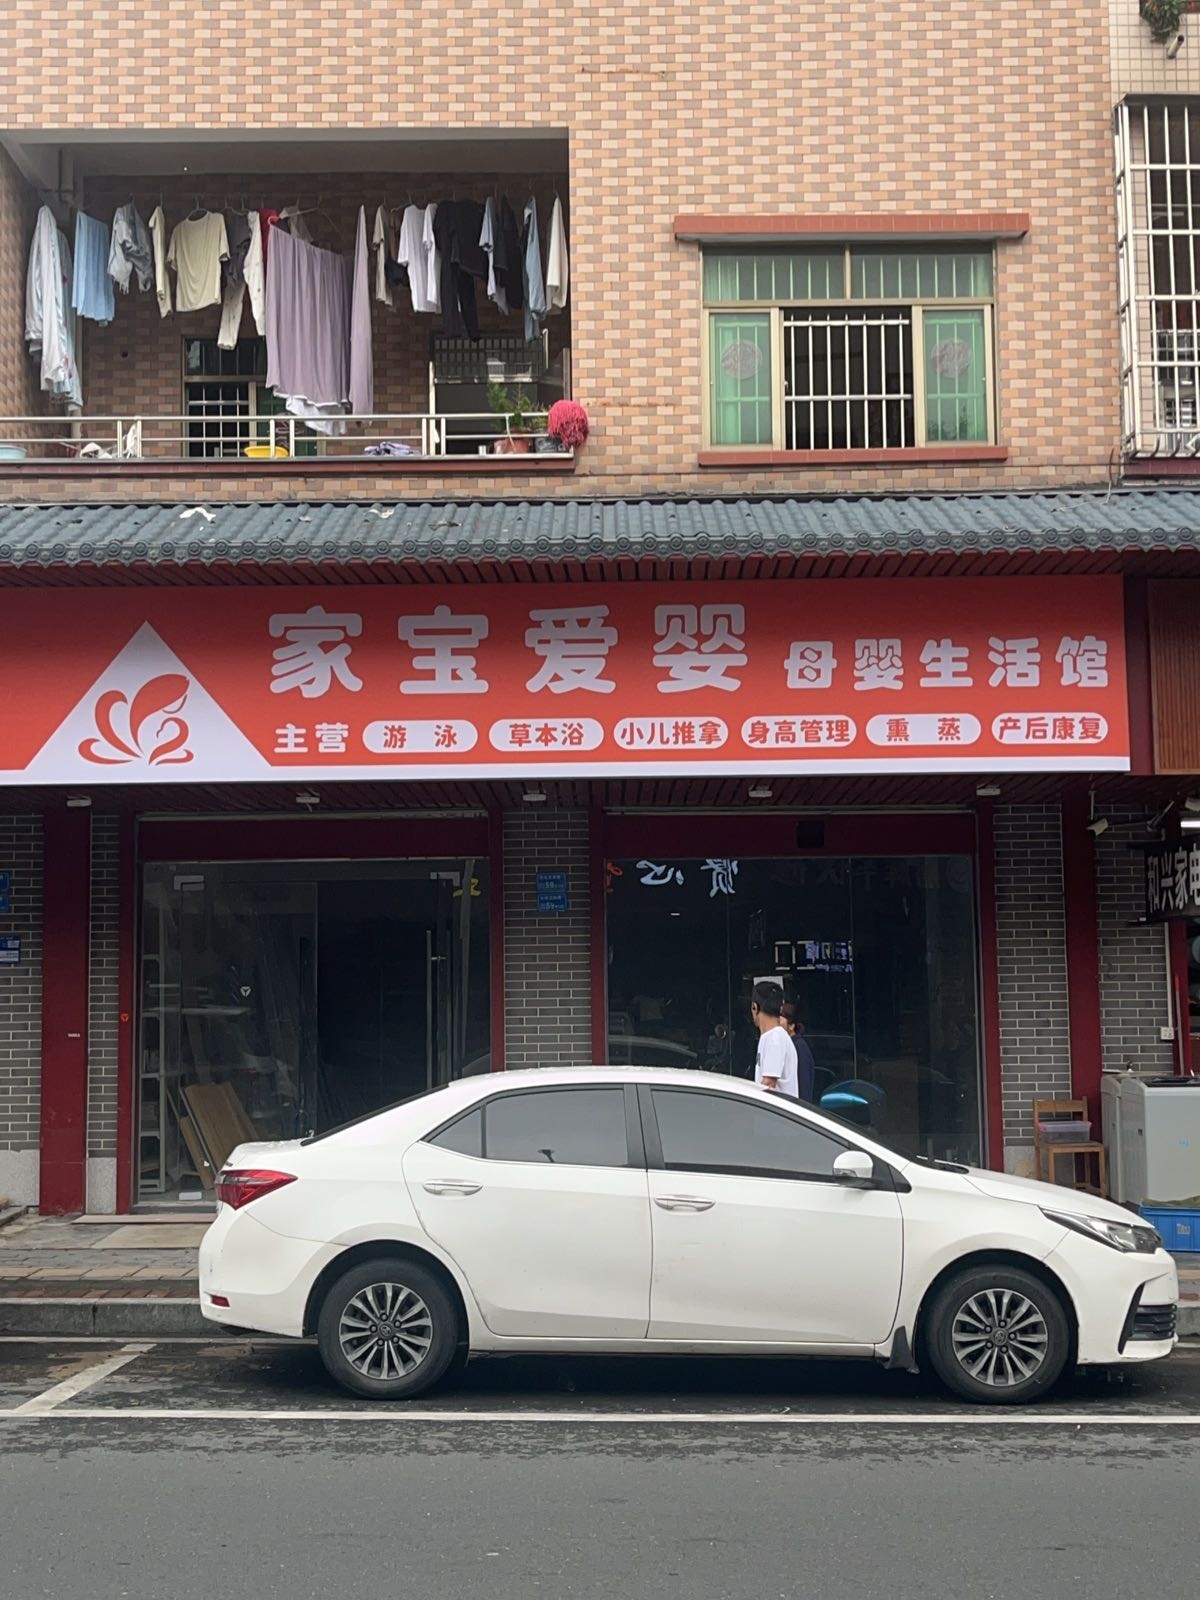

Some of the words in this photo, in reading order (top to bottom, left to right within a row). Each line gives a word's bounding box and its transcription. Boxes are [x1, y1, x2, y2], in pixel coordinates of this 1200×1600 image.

[269, 604, 748, 698] 家宝爱婴
[784, 636, 1108, 691] 母婴生活馆
[274, 722, 350, 754] 主营
[383, 725, 458, 748] 游泳
[509, 724, 585, 747] 草本浴
[620, 720, 725, 745] 小儿推拿
[747, 719, 852, 743] 身高管理
[886, 717, 962, 741] 熏蒸
[998, 715, 1101, 739] 产后康复
